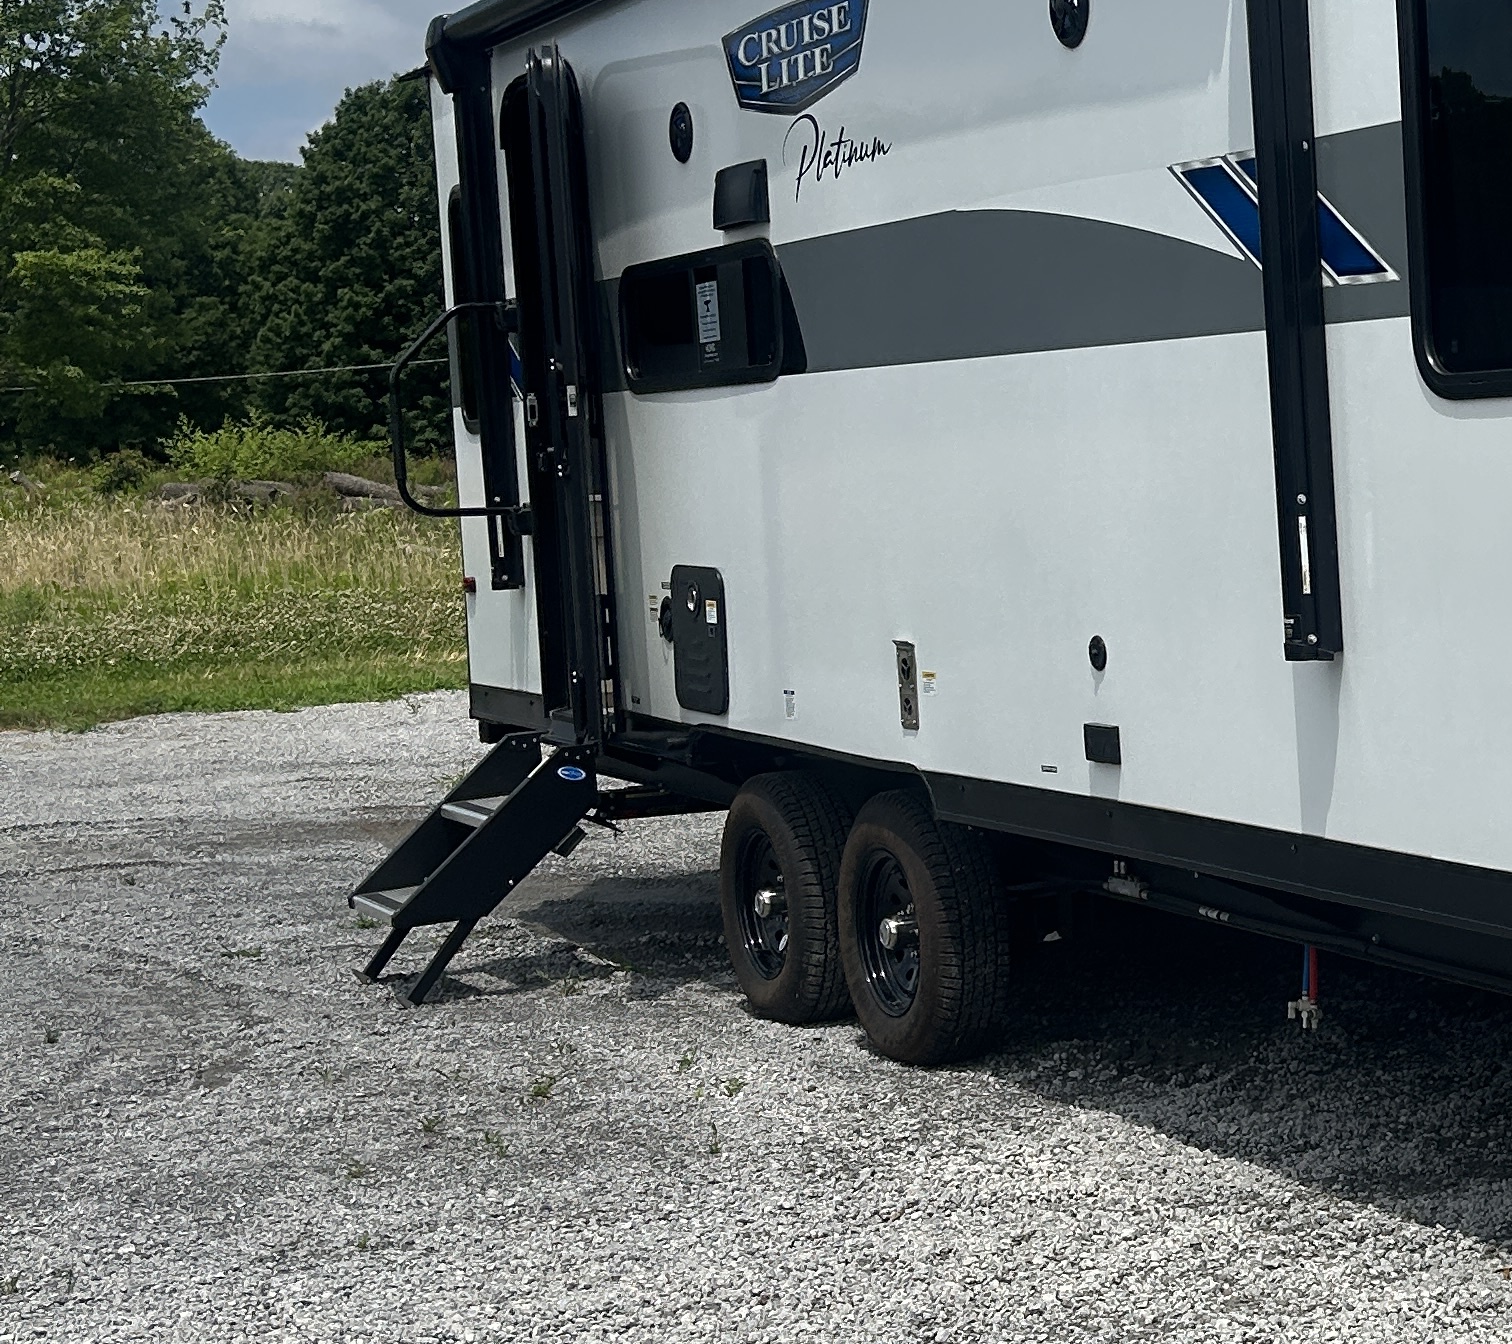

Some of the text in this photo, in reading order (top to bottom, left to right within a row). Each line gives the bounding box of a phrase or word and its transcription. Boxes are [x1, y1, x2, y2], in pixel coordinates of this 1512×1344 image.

[737, 0, 852, 67] CRUISE
[757, 43, 834, 96] LITE
[782, 113, 893, 204] Platinum
